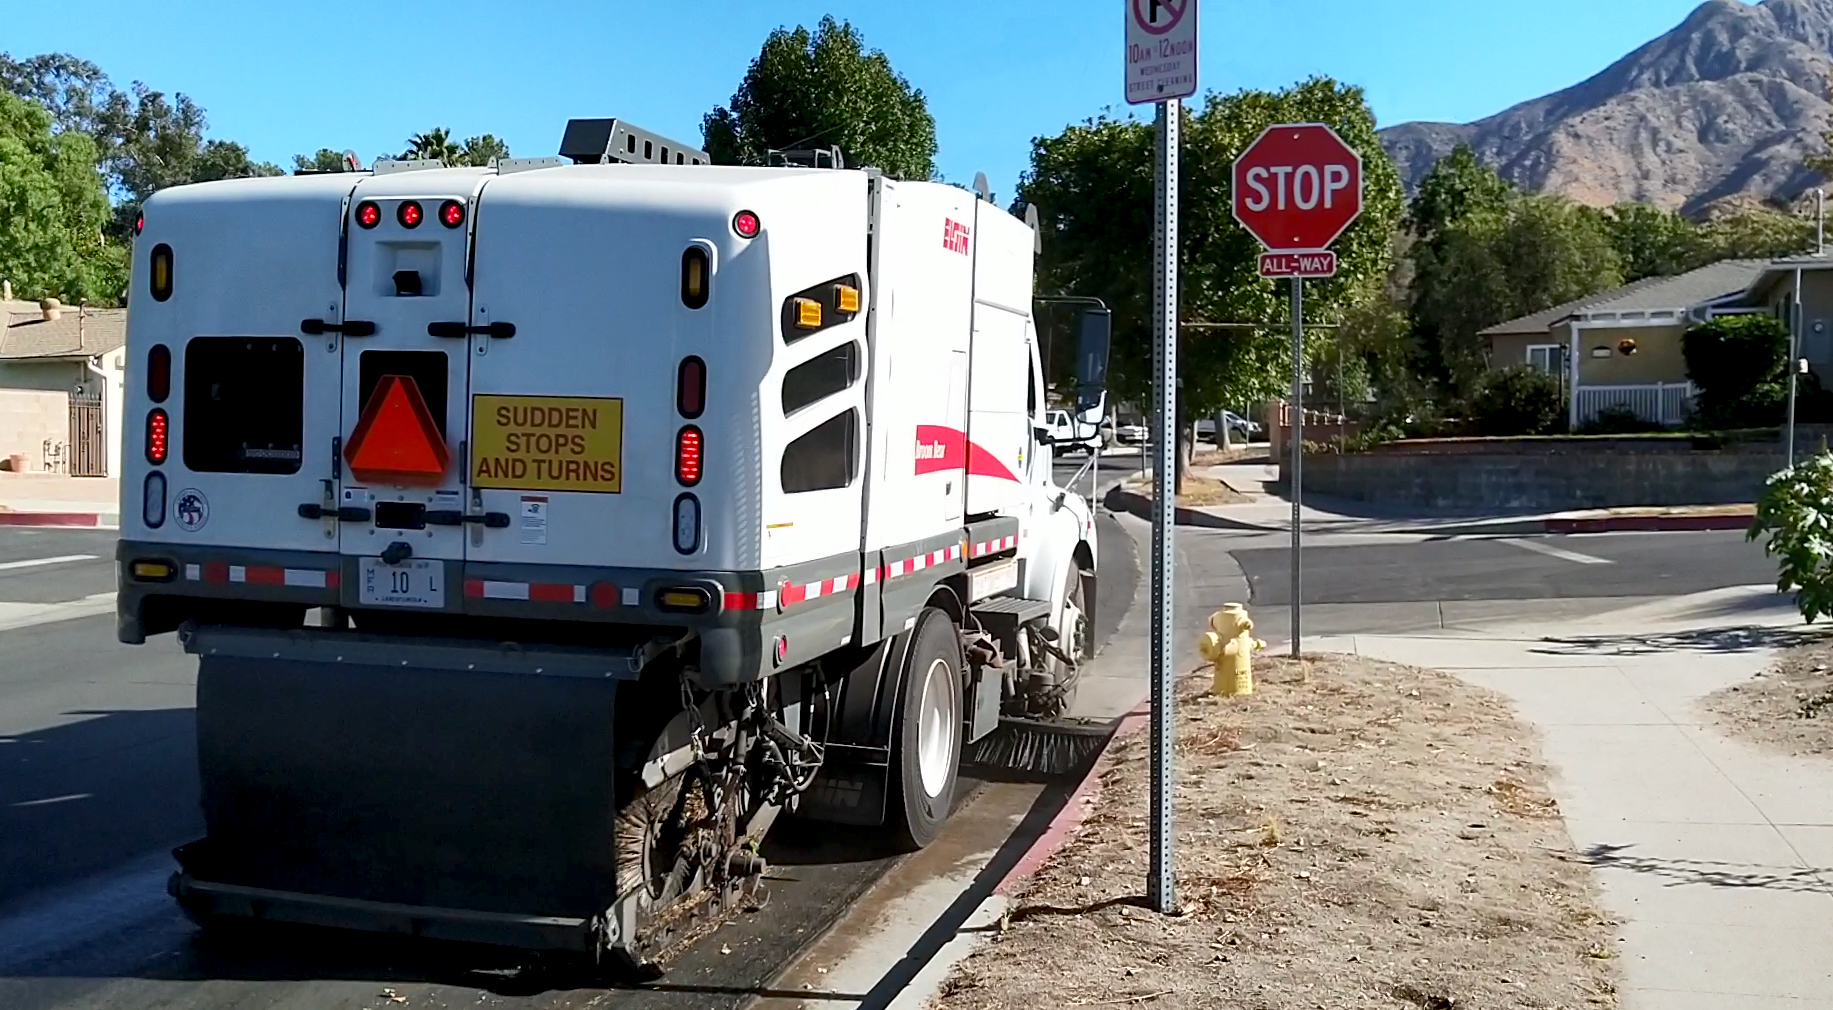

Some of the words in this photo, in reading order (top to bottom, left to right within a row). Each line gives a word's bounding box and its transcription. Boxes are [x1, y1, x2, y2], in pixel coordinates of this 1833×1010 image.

[1140, 61, 1180, 76] WEDNESDAY
[1128, 80, 1154, 93] STREET
[1157, 73, 1193, 88] CLEANING
[1245, 164, 1349, 212] STOP
[1262, 256, 1332, 273] ALL-WAY
[496, 406, 598, 430] SUDDEN
[505, 432, 586, 456] STOPS
[476, 457, 527, 479] AND
[532, 459, 616, 482] TURNS
[390, 571, 409, 593] 10
[429, 575, 437, 592] L
